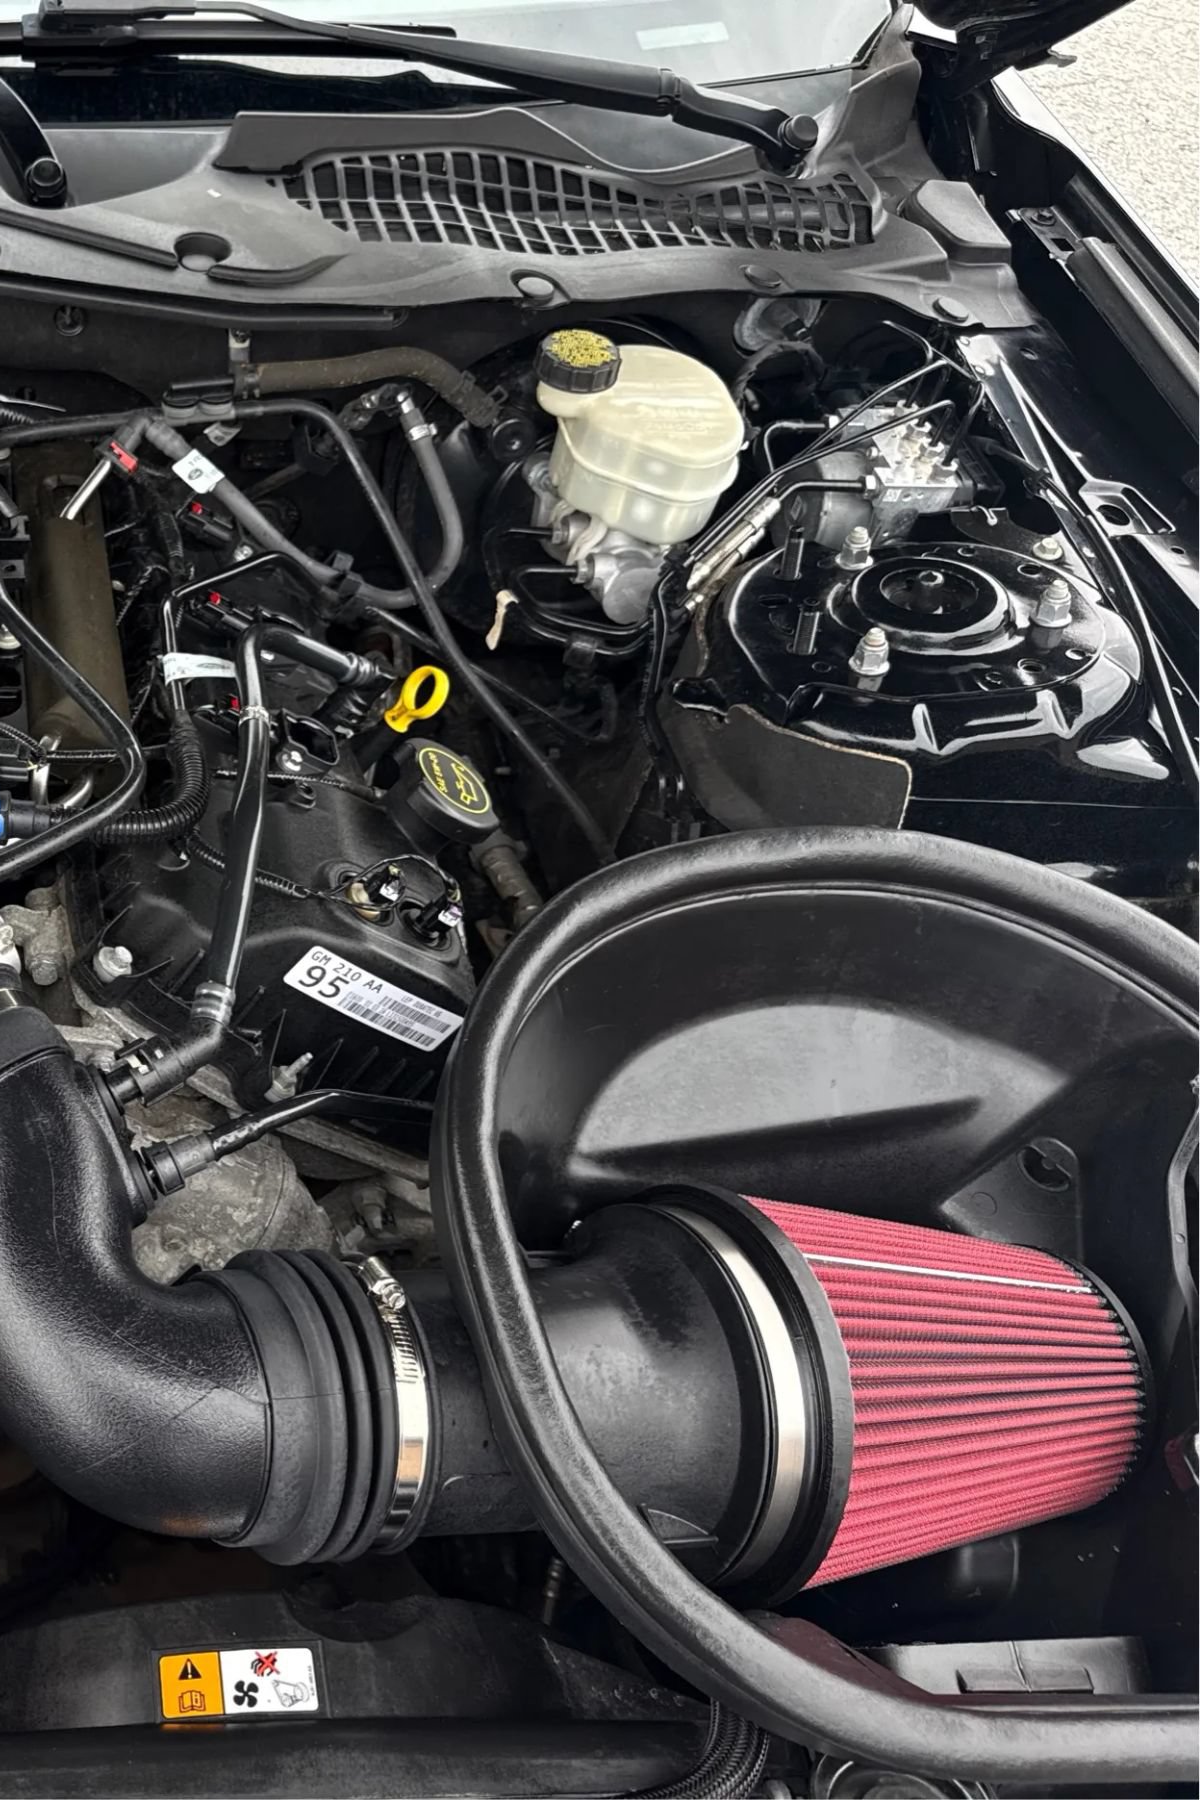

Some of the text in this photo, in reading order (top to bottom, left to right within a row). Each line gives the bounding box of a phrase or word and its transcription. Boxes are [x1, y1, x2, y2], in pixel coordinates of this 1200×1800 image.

[298, 965, 350, 999] 95
[311, 950, 384, 994] GM 210 AA
